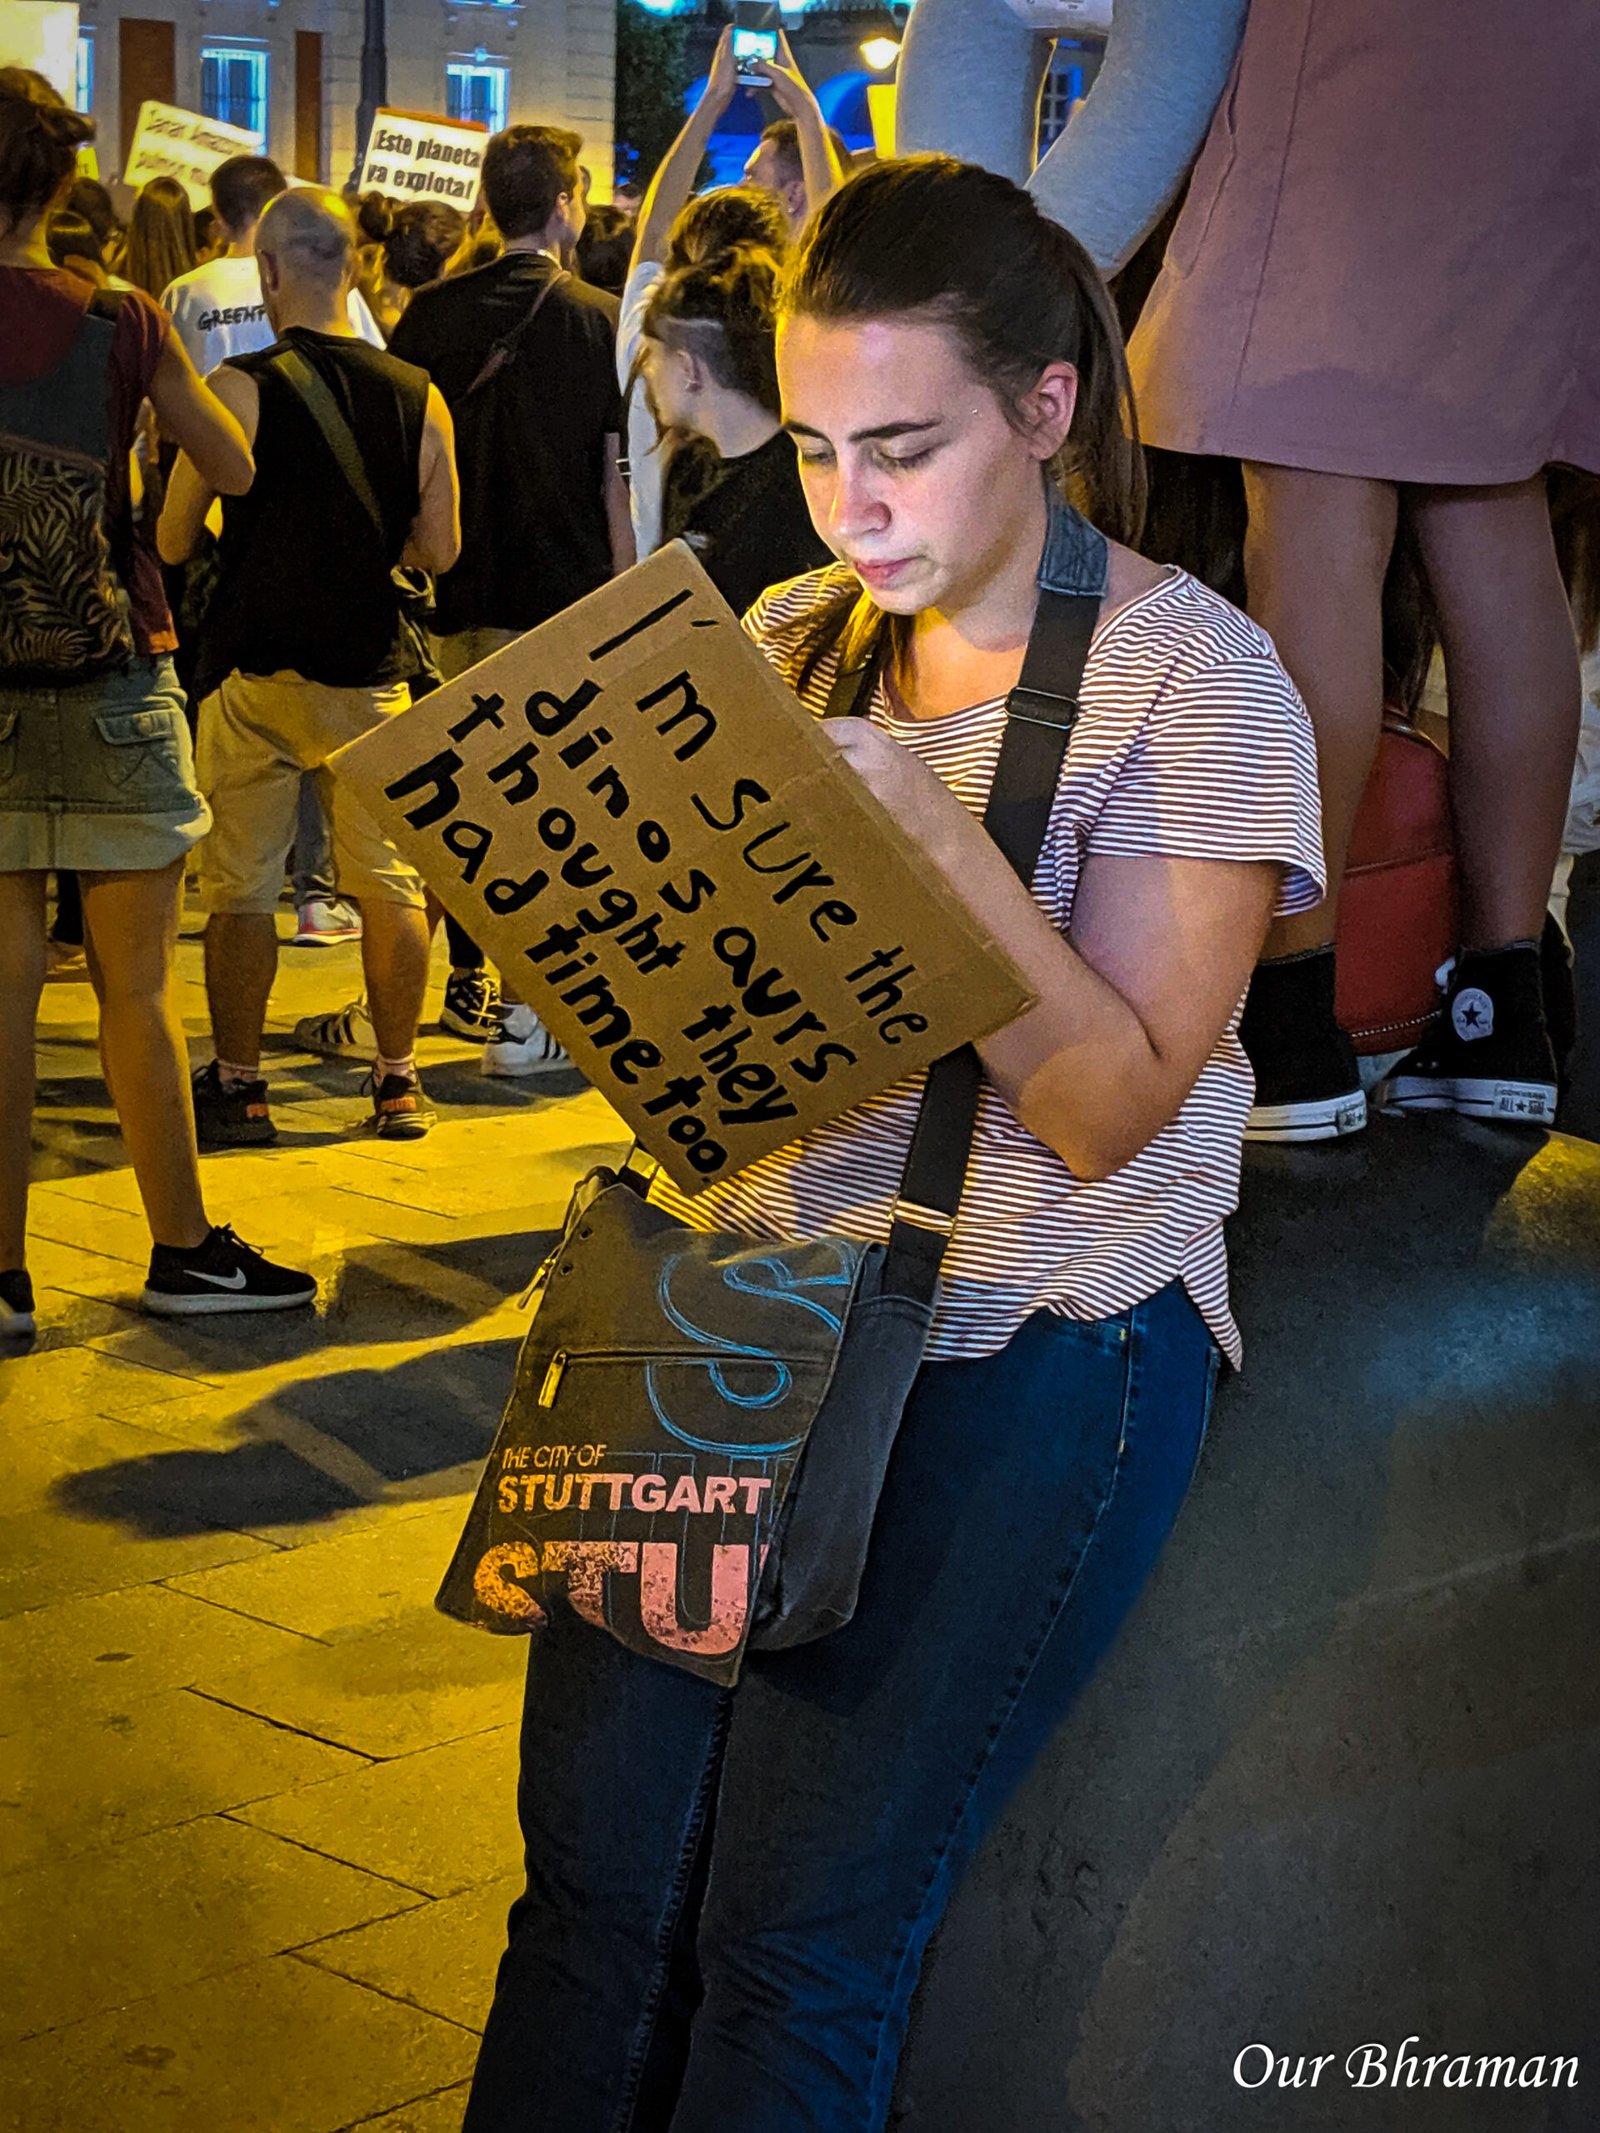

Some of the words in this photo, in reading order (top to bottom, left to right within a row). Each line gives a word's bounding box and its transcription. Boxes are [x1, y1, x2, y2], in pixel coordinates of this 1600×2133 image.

[372, 129, 413, 156] Este
[416, 138, 481, 168] planeta
[446, 693, 687, 975] thought
[681, 1003, 799, 1126] they
[588, 588, 719, 762] I'm
[690, 778, 858, 943] sure
[844, 945, 929, 1045] the
[383, 748, 550, 916] had
[524, 922, 666, 1085] time
[498, 1472, 772, 1515] STUTTGART
[577, 1443, 608, 1467] OF
